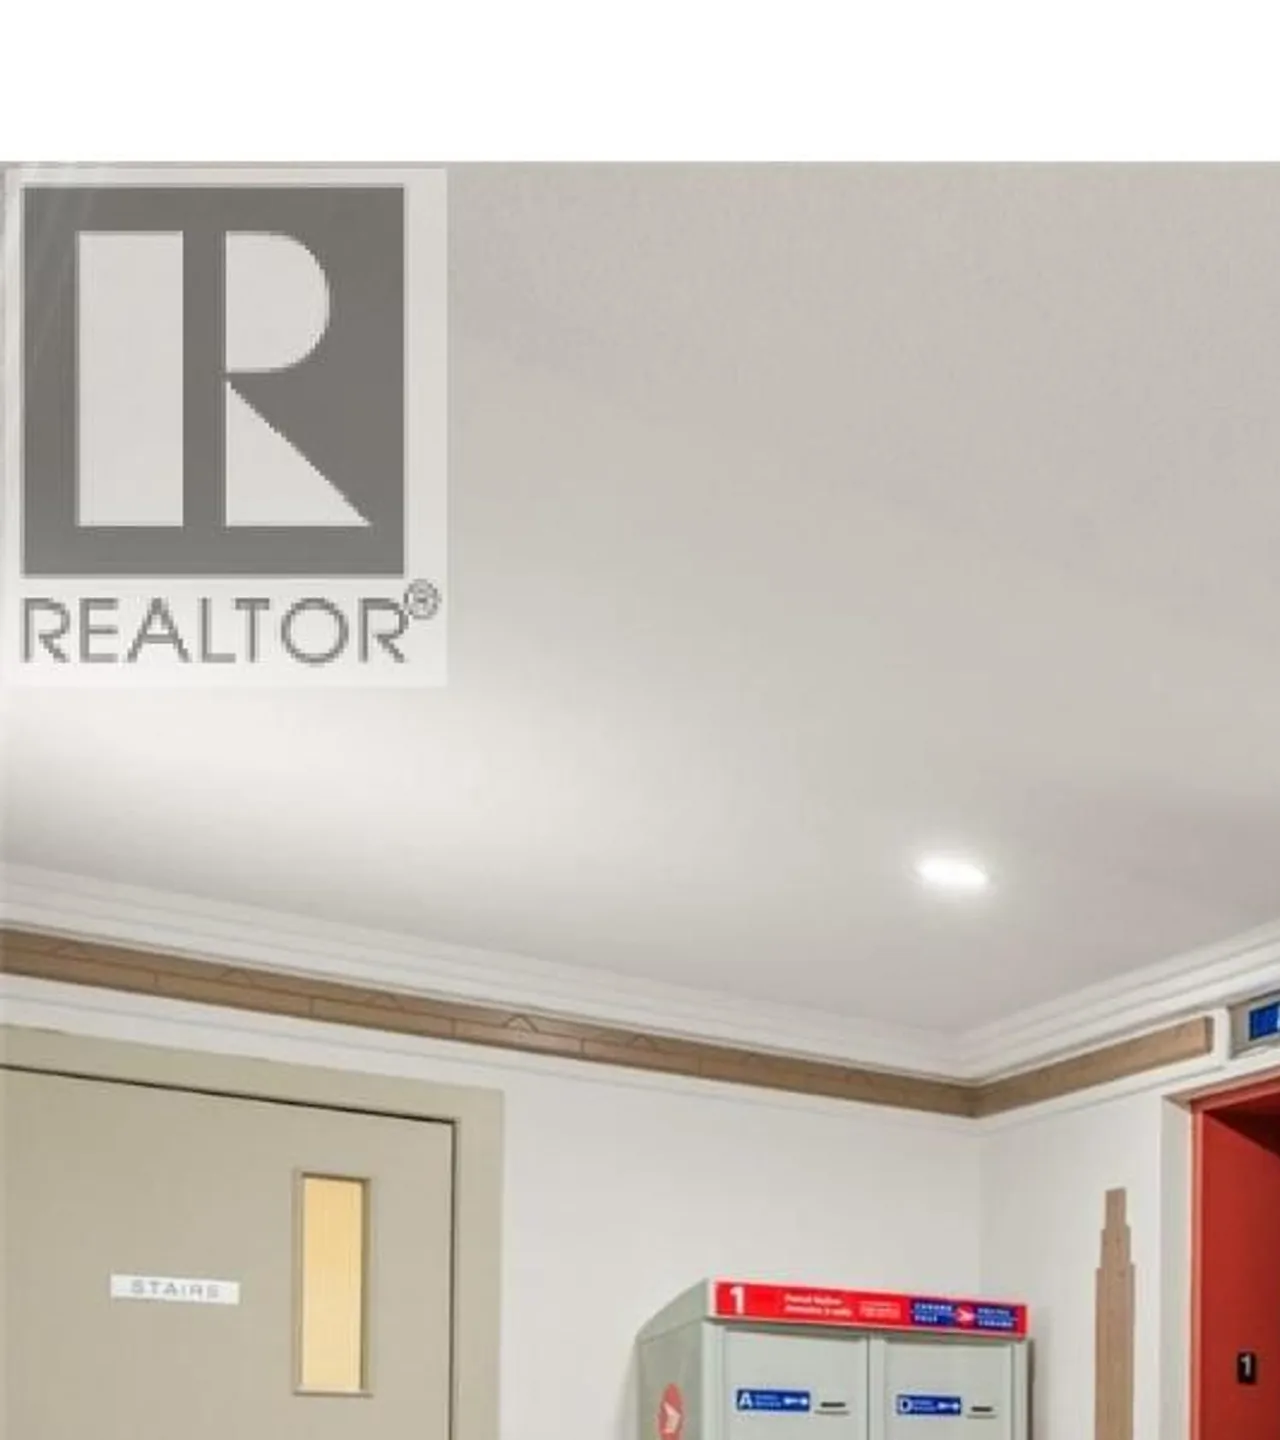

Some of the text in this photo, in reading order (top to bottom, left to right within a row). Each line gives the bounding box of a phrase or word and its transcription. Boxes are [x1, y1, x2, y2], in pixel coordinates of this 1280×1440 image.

[131, 1278, 220, 1298] STAIRS
[729, 1286, 746, 1315] 1
[1241, 1353, 1252, 1377] 1
[739, 1391, 753, 1408] A
[900, 1398, 913, 1412] D
